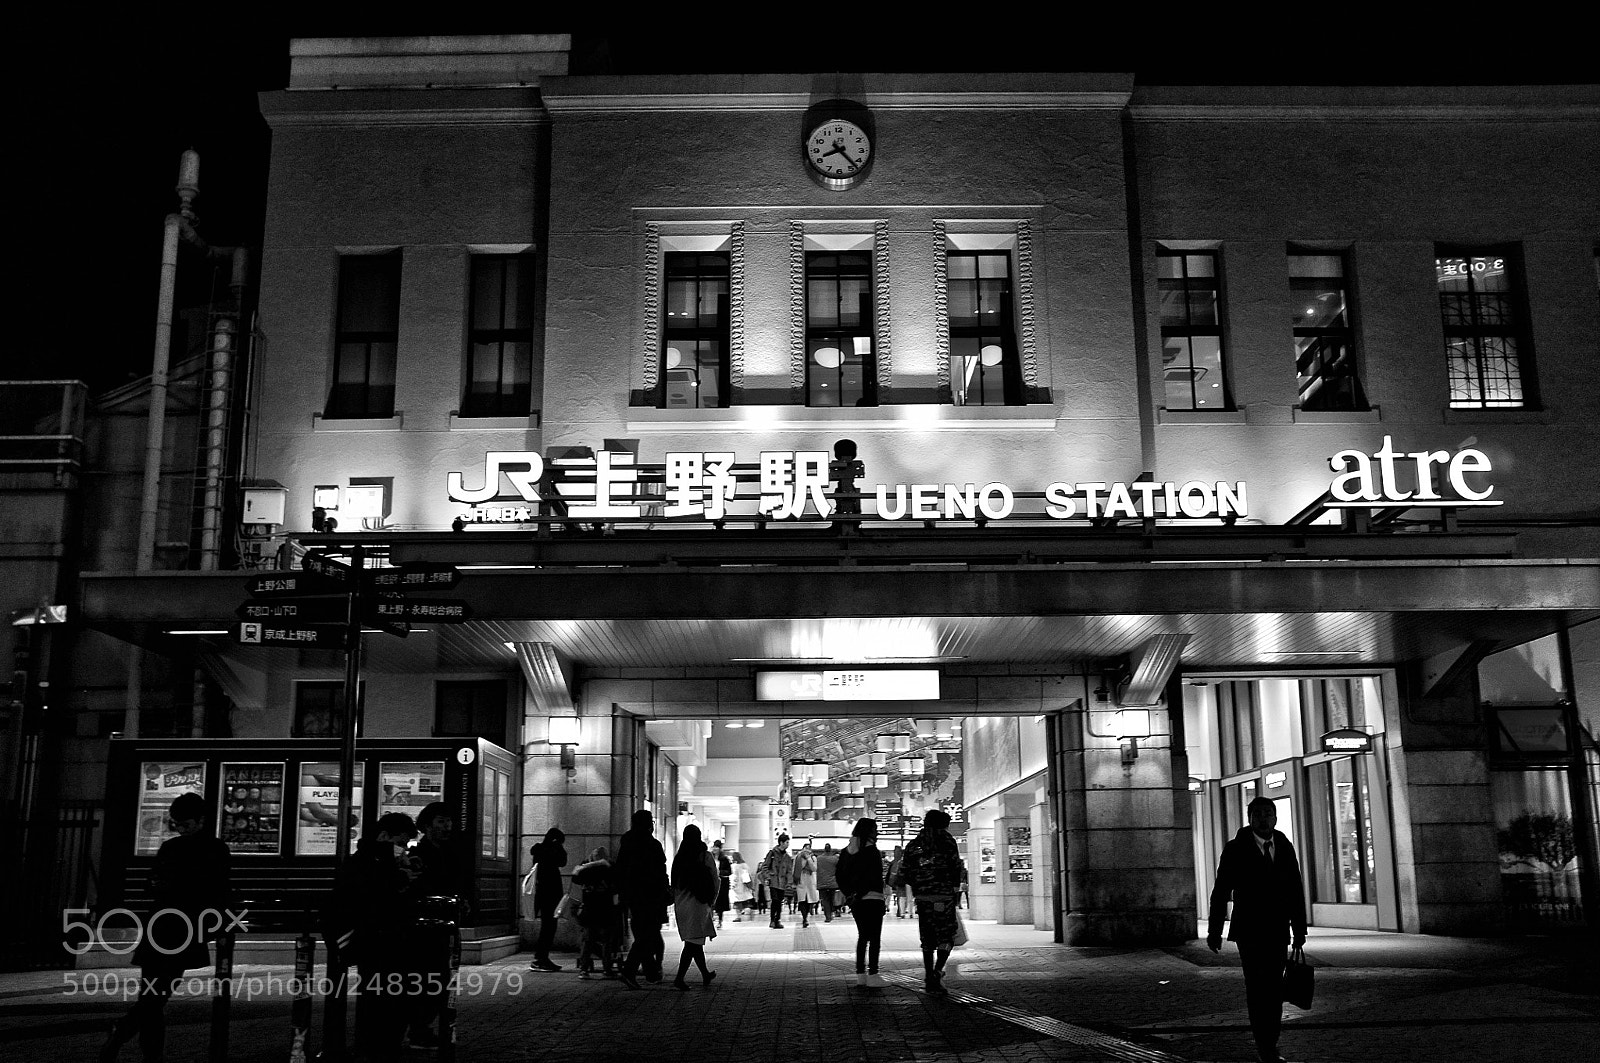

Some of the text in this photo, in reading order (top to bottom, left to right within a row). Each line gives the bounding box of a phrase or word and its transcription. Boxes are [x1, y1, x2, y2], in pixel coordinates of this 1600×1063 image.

[448, 450, 833, 519] JR 上野駅
[876, 480, 1248, 520] UENO STATION
[255, 578, 297, 592] 上野公園
[264, 629, 317, 642] 京成上野駅
